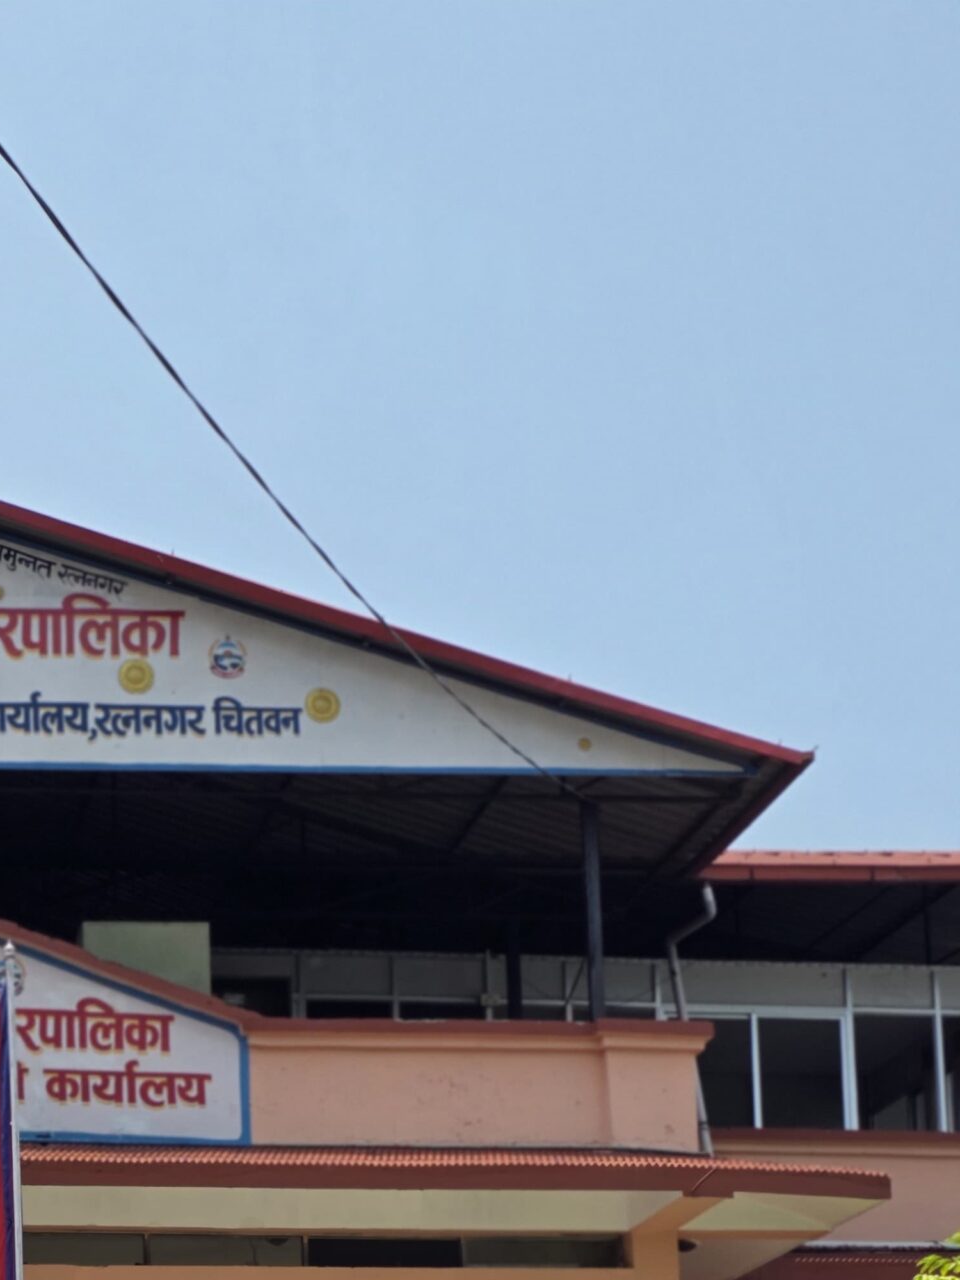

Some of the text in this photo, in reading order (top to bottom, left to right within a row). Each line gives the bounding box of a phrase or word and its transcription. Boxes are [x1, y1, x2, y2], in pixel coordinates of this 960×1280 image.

[57, 562, 129, 596] रत्ननगर
[213, 696, 303, 737] चितवन
[42, 1060, 212, 1108] कार्यालय
